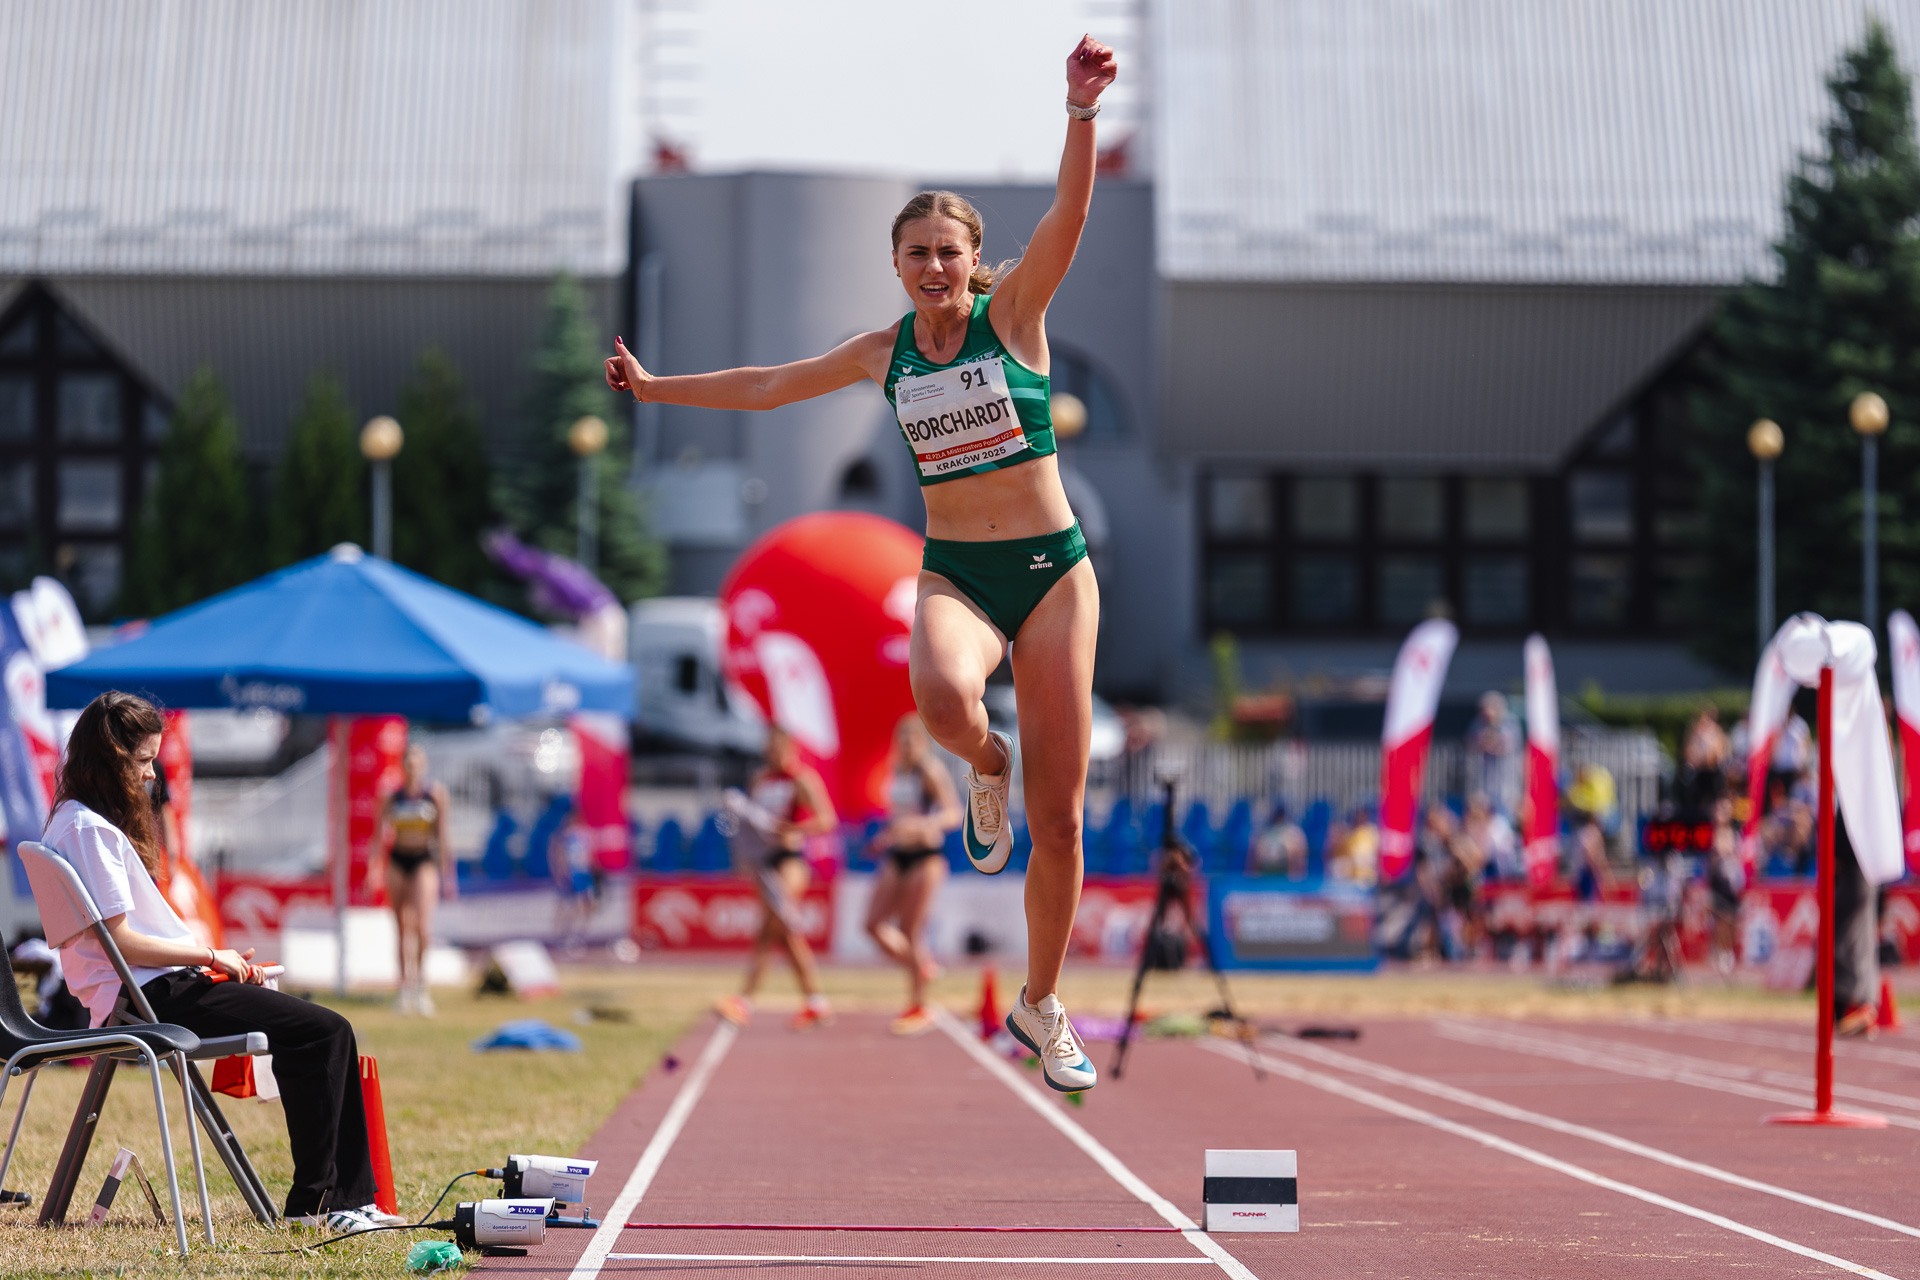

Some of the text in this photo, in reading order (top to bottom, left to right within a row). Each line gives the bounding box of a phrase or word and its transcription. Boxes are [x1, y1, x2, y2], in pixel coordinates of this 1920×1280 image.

[960, 366, 988, 391] 91
[905, 397, 1011, 443] BORCHARDT
[946, 443, 983, 456] Mistrzostwa
[982, 436, 1001, 447] Polski
[1001, 431, 1014, 440] U23
[936, 445, 1007, 472] KRAKÓW 2025
[1030, 562, 1053, 570] erima
